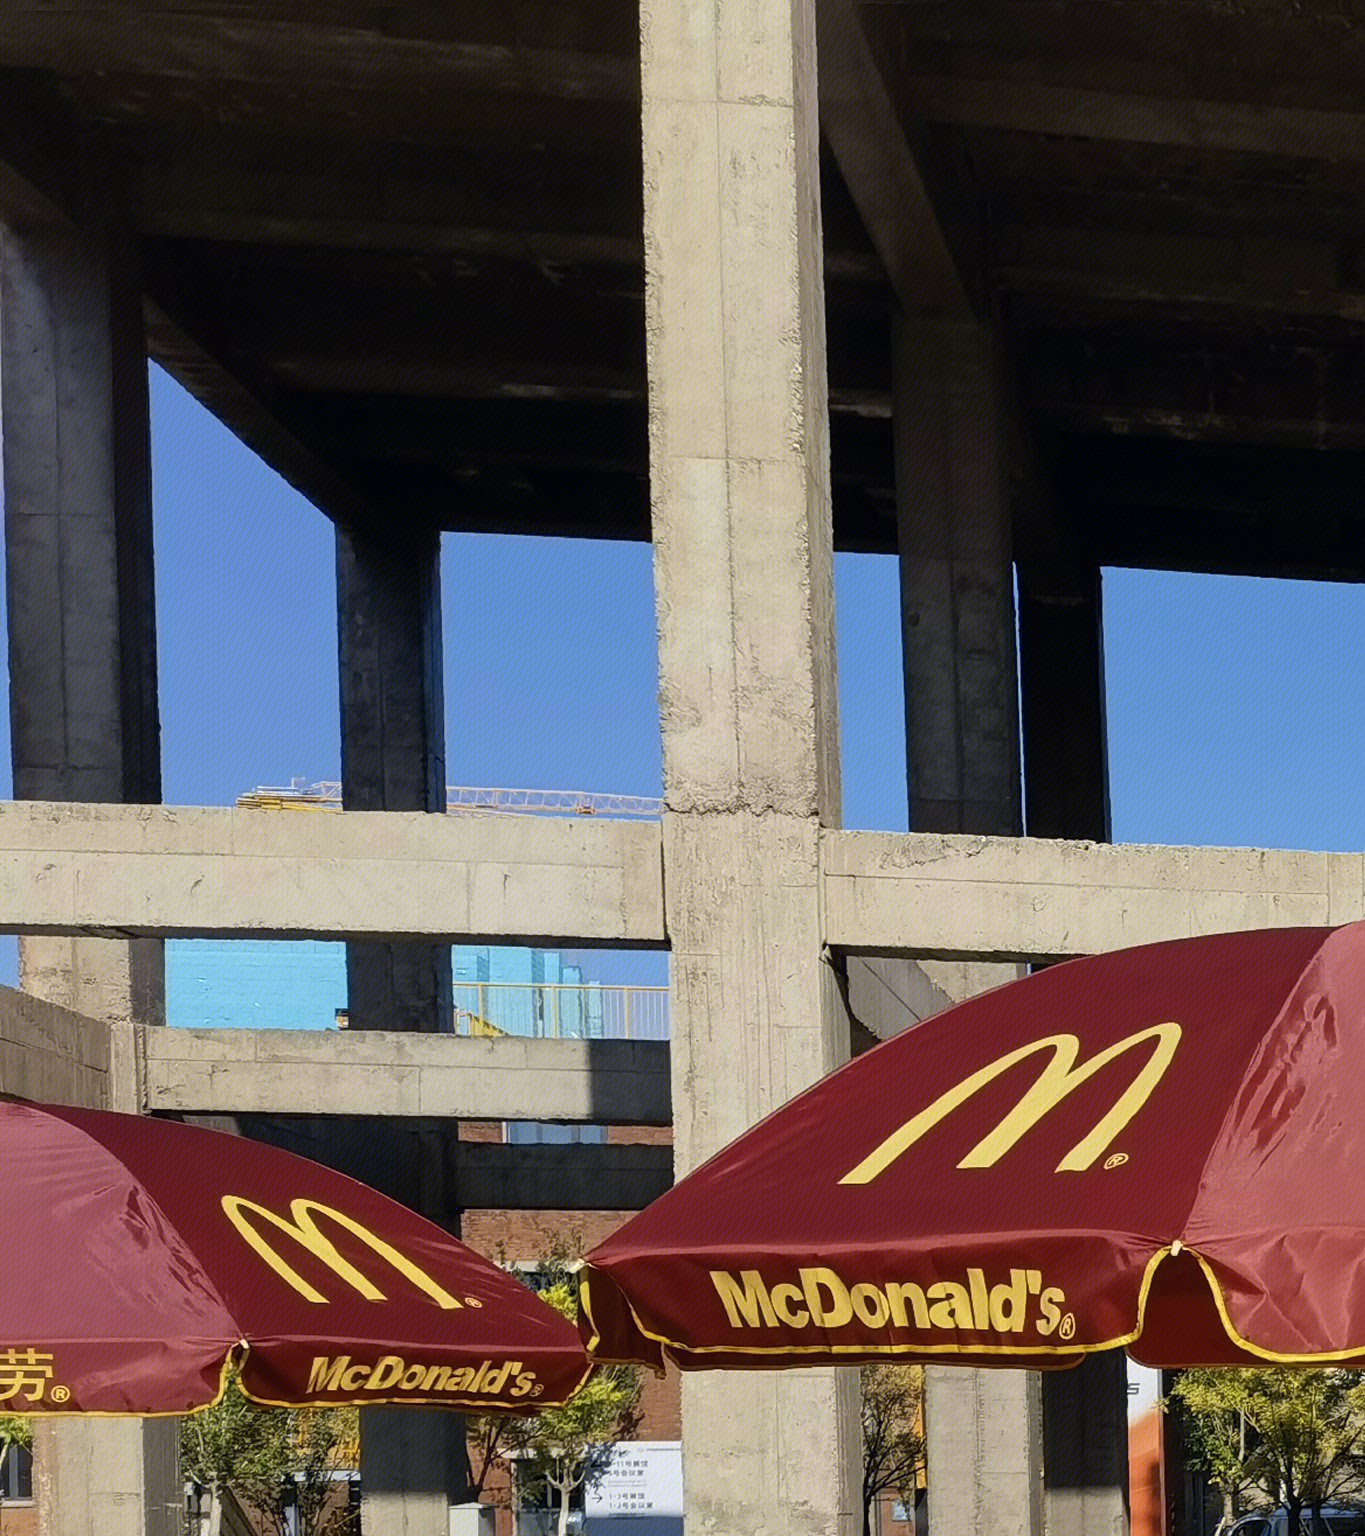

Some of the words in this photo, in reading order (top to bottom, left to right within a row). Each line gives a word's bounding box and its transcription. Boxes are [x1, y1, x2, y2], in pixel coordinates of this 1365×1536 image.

[709, 1266, 1064, 1336] McDonald's
[0, 1347, 54, 1402] 劳
[305, 1355, 537, 1397] McDonald's
